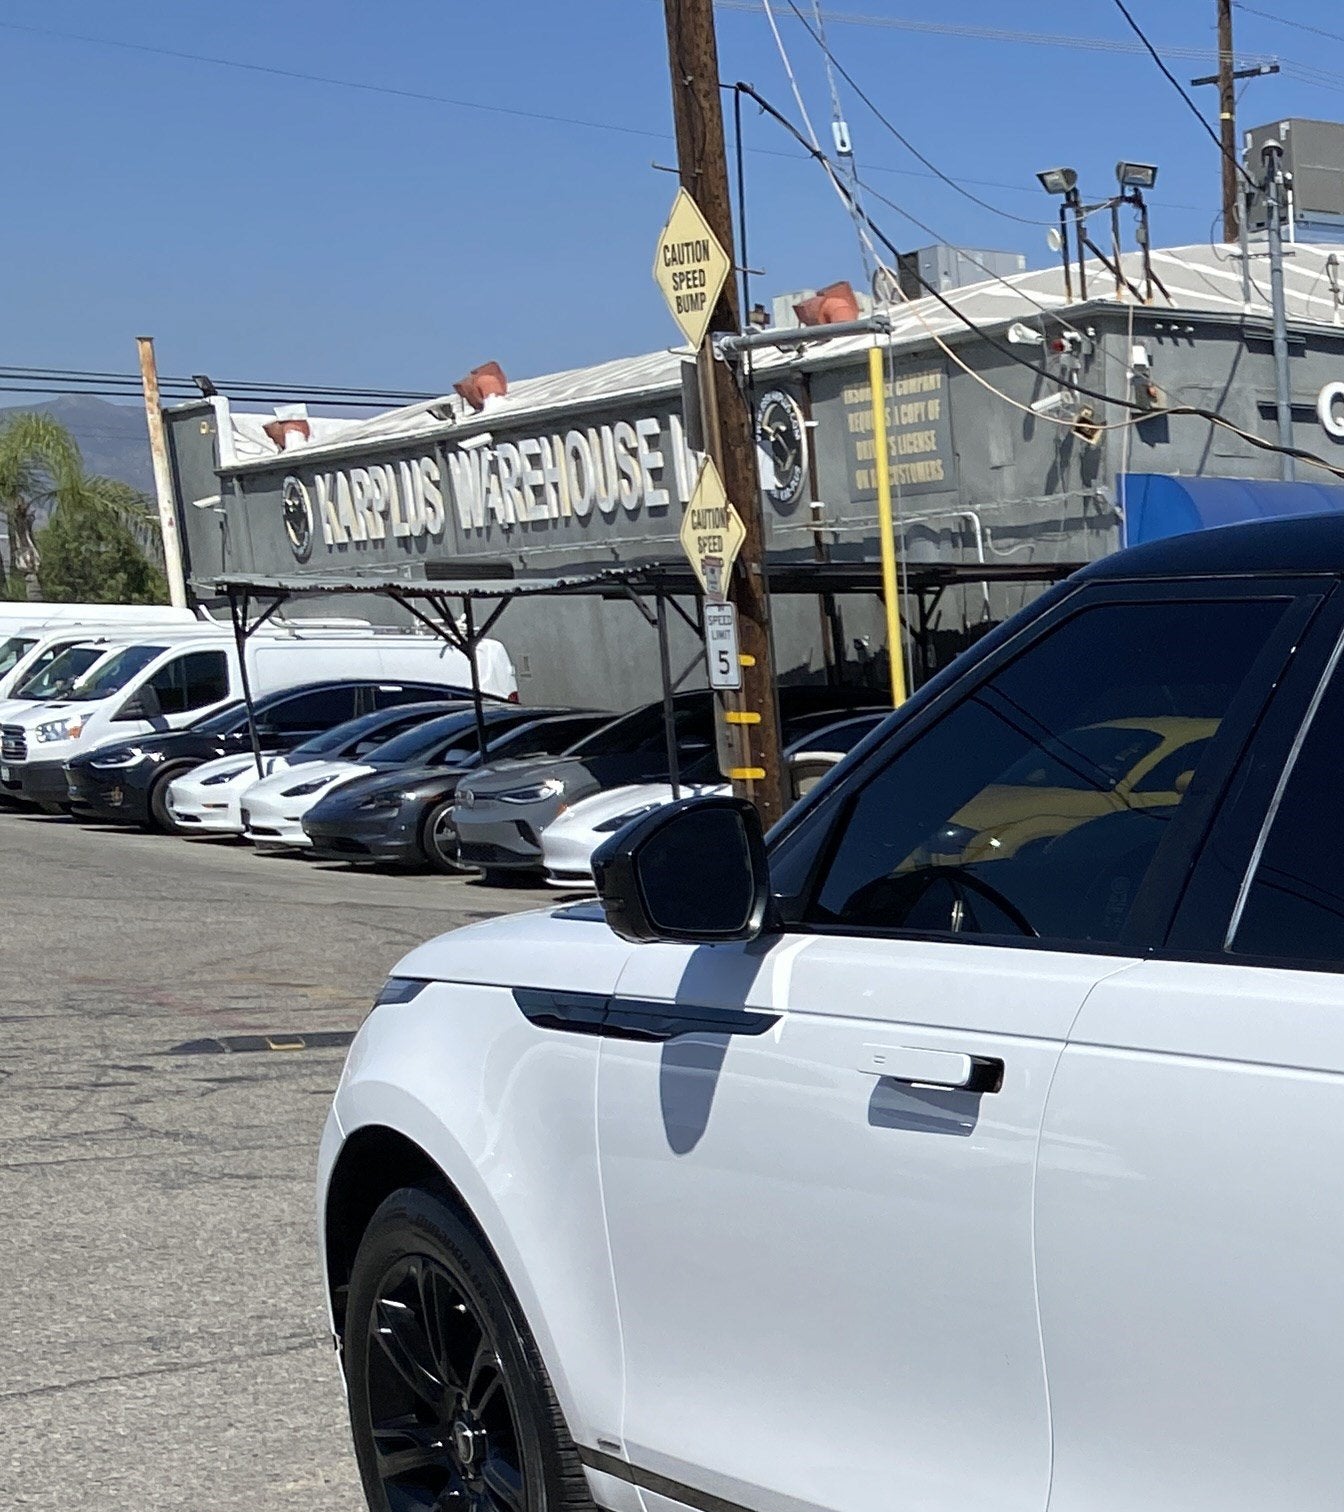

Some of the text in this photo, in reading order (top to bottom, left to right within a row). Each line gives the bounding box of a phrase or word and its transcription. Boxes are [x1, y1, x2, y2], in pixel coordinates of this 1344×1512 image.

[663, 239, 710, 267] CAUTION
[672, 268, 706, 291] SPEED
[675, 292, 707, 314] BUMP
[314, 456, 445, 545] KARPLUS
[448, 417, 670, 530] WAREHOUSE
[691, 507, 727, 530] CAUTION
[697, 535, 723, 554] SPEED
[708, 615, 732, 626] SPEED
[711, 629, 731, 641] LIMIT
[718, 650, 730, 675] 5
